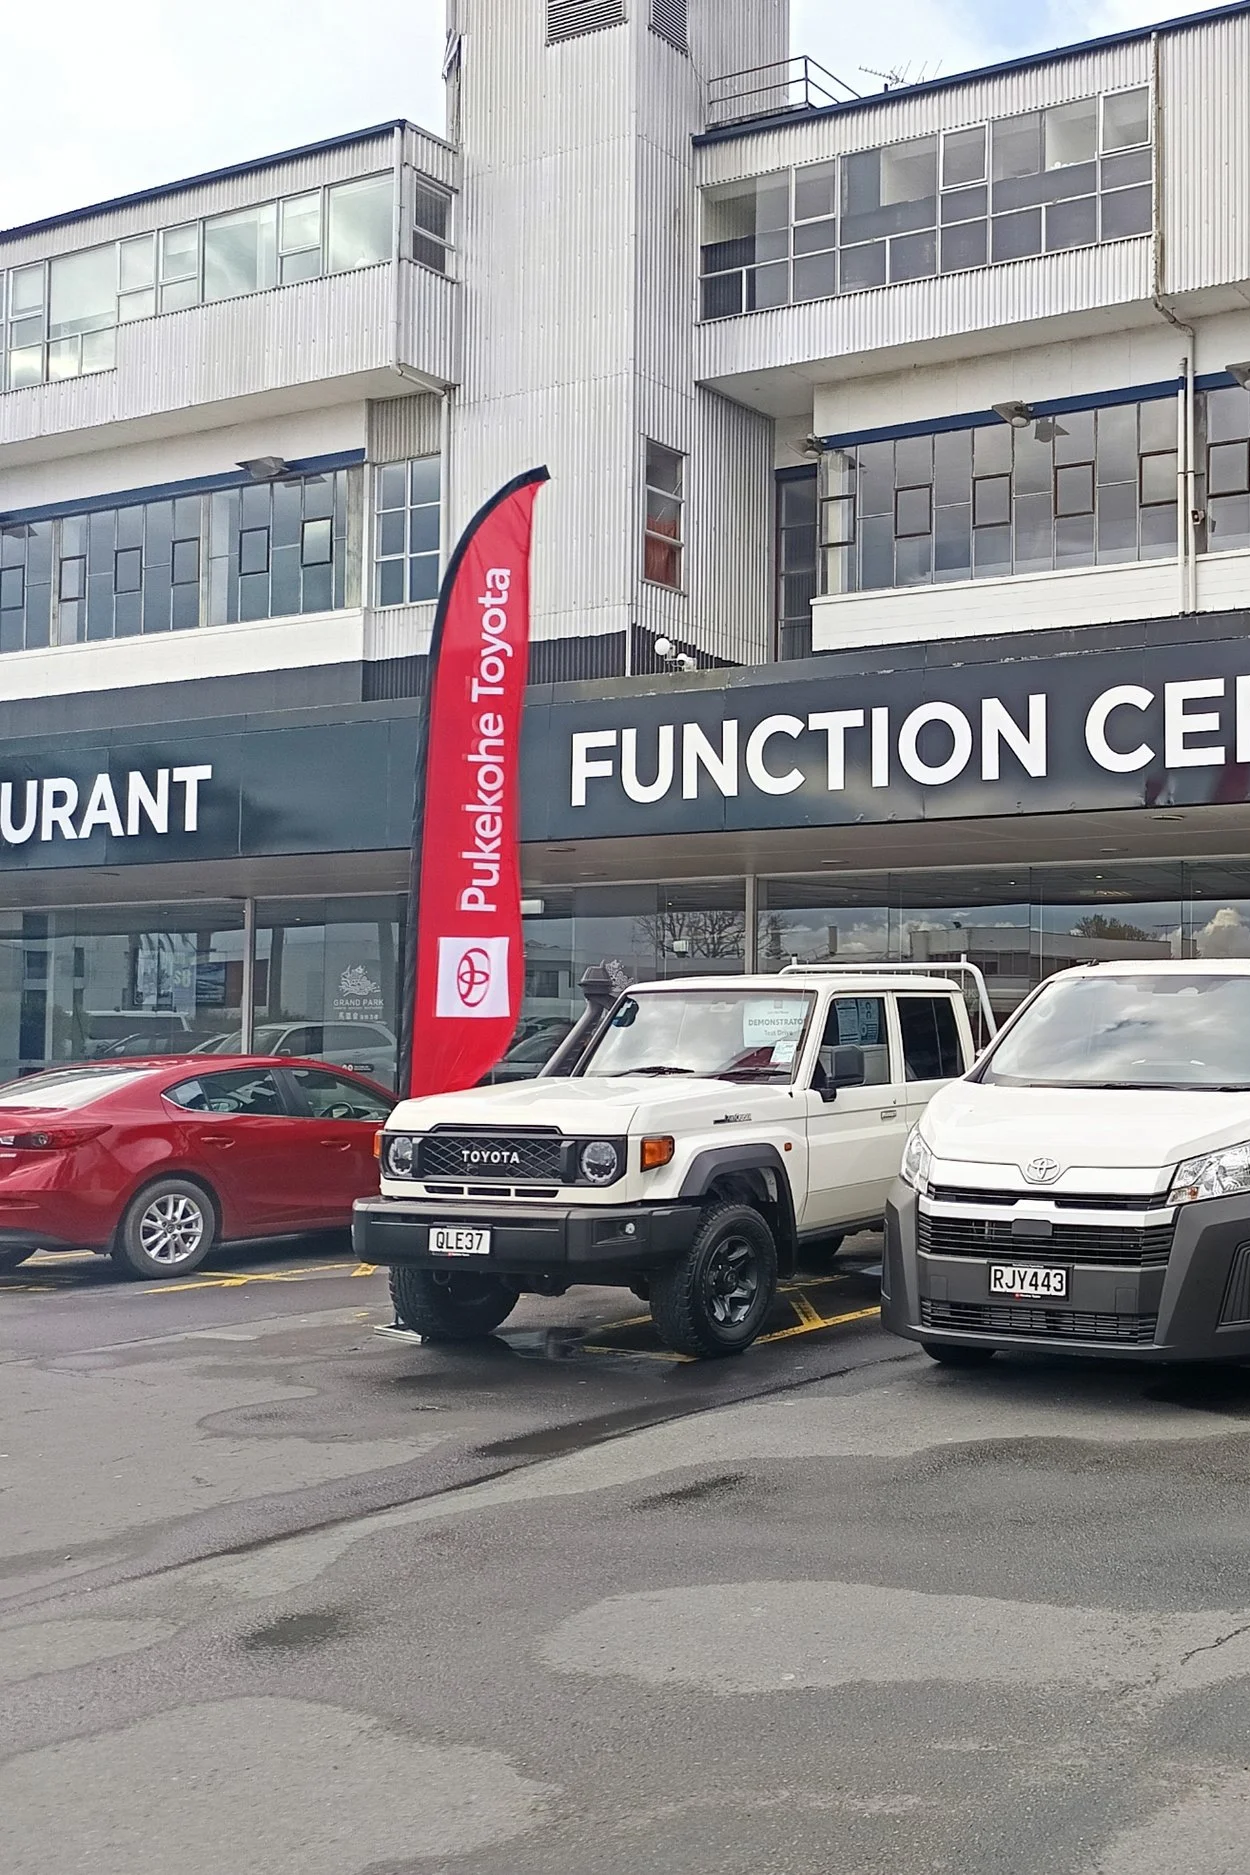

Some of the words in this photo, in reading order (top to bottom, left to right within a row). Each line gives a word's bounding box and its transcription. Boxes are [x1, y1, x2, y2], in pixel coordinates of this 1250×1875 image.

[470, 567, 513, 703] Toyota
[571, 693, 1048, 806] FUNCTION
[0, 764, 213, 844] URANT
[459, 712, 504, 912] Pukekohe
[333, 999, 361, 1007] GRAND
[362, 998, 384, 1006] PARK
[461, 1150, 520, 1164] TOYOTA
[436, 1231, 484, 1251] QLE37
[993, 1268, 1064, 1292] RJY443
